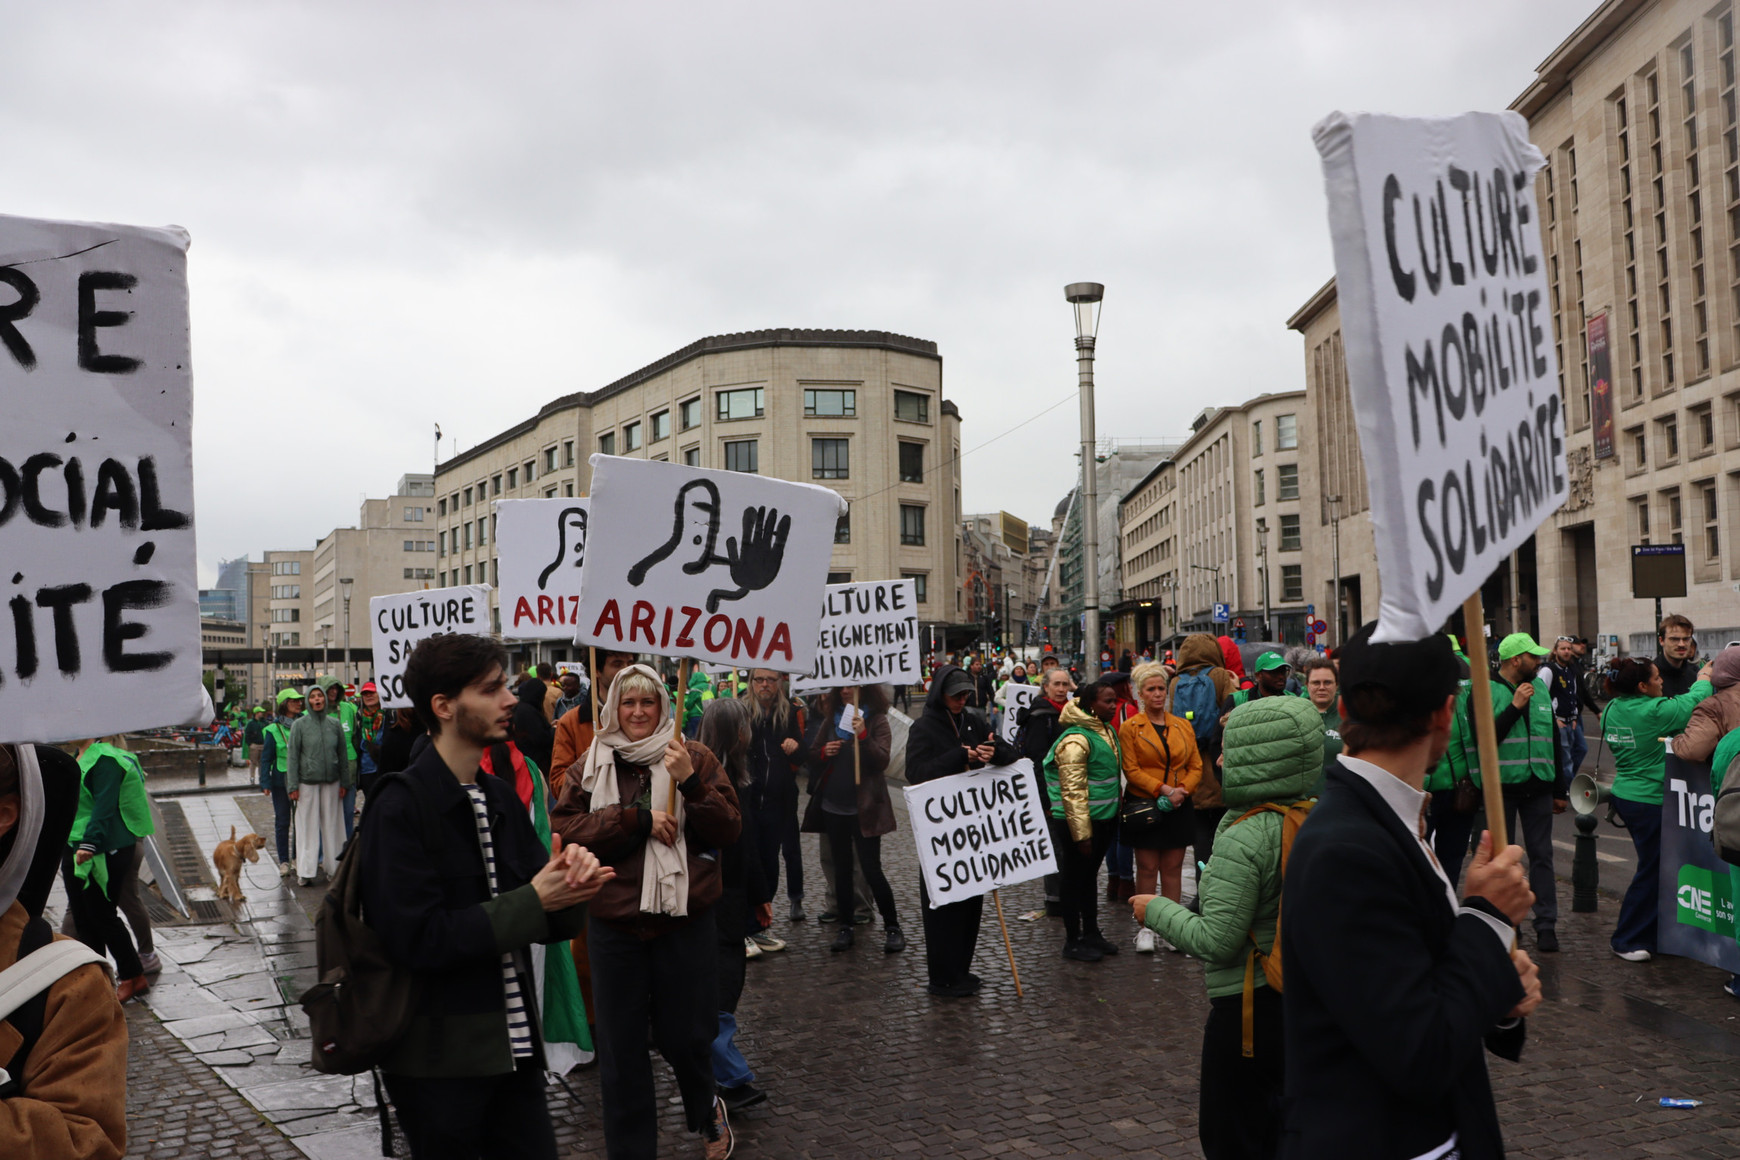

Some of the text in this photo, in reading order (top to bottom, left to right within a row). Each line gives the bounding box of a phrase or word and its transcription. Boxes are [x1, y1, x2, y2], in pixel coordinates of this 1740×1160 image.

[1383, 164, 1537, 304] CULTURE
[378, 597, 475, 633] CULTURE
[593, 599, 794, 662] ARIZONA
[817, 617, 916, 649] EIGNEMENT
[925, 774, 1028, 824] CULTURE
[931, 801, 1036, 856] MOBILITÉ
[936, 828, 1050, 892] SOLIDARITÉ
[1677, 884, 1712, 916] CNE
